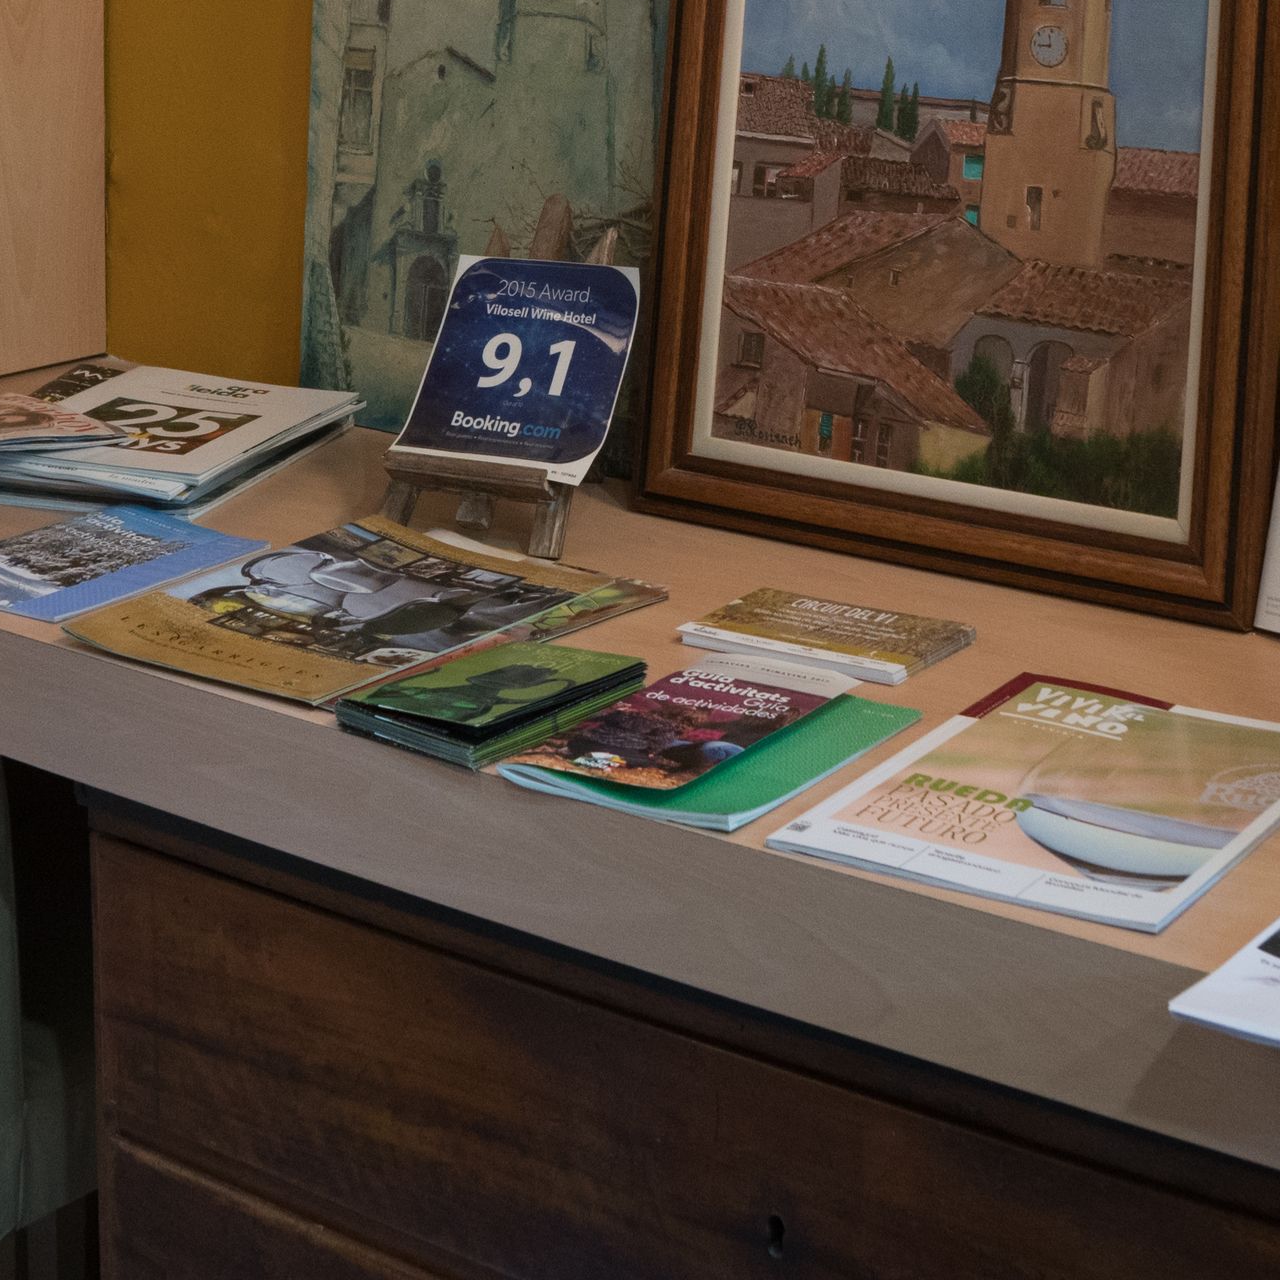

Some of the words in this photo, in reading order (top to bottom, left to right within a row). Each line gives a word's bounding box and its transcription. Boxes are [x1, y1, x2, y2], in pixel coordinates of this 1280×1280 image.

[497, 279, 537, 298] 2015
[538, 283, 591, 303] Award
[486, 304, 529, 318] Vilosell
[531, 307, 562, 321] Wine
[563, 311, 596, 324] Hotel
[477, 332, 577, 398] 9,1
[106, 402, 243, 439] 25
[450, 410, 562, 440] Booking.com
[791, 598, 851, 615] CIRCUIT
[844, 607, 876, 621] DEL
[646, 690, 670, 702] de
[672, 696, 779, 720] actividades
[670, 676, 791, 703] d'activitats
[1017, 702, 1129, 735] VINO
[873, 795, 998, 832] PRESENTE
[887, 784, 1018, 825] PASADO
[856, 805, 988, 845] FUTURO
